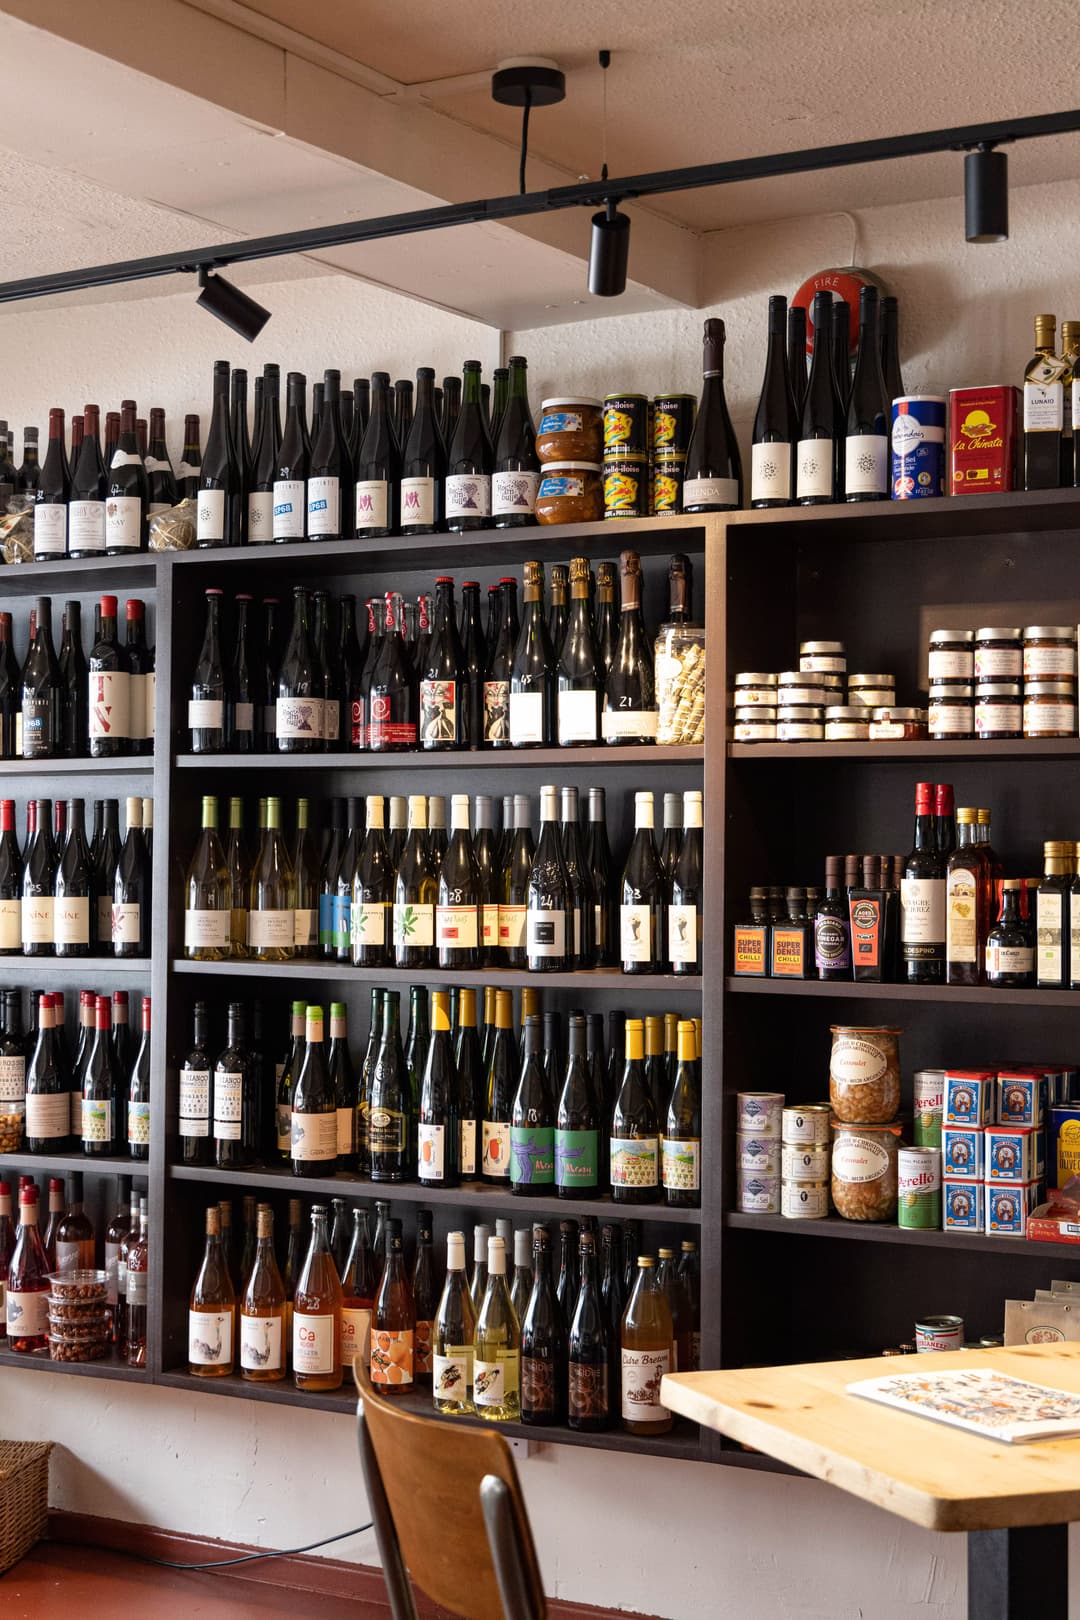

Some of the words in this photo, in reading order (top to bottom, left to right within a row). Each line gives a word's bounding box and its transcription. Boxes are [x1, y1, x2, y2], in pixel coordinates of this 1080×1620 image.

[814, 277, 840, 289] FIRE
[953, 440, 970, 451] La
[972, 437, 1004, 450] Chinata
[521, 674, 532, 685] 45
[297, 682, 309, 694] 19
[619, 697, 632, 707] 21
[449, 889, 466, 903] 28
[540, 894, 553, 910] 24
[738, 939, 762, 947] SUPER
[299, 1327, 316, 1342] Ca
